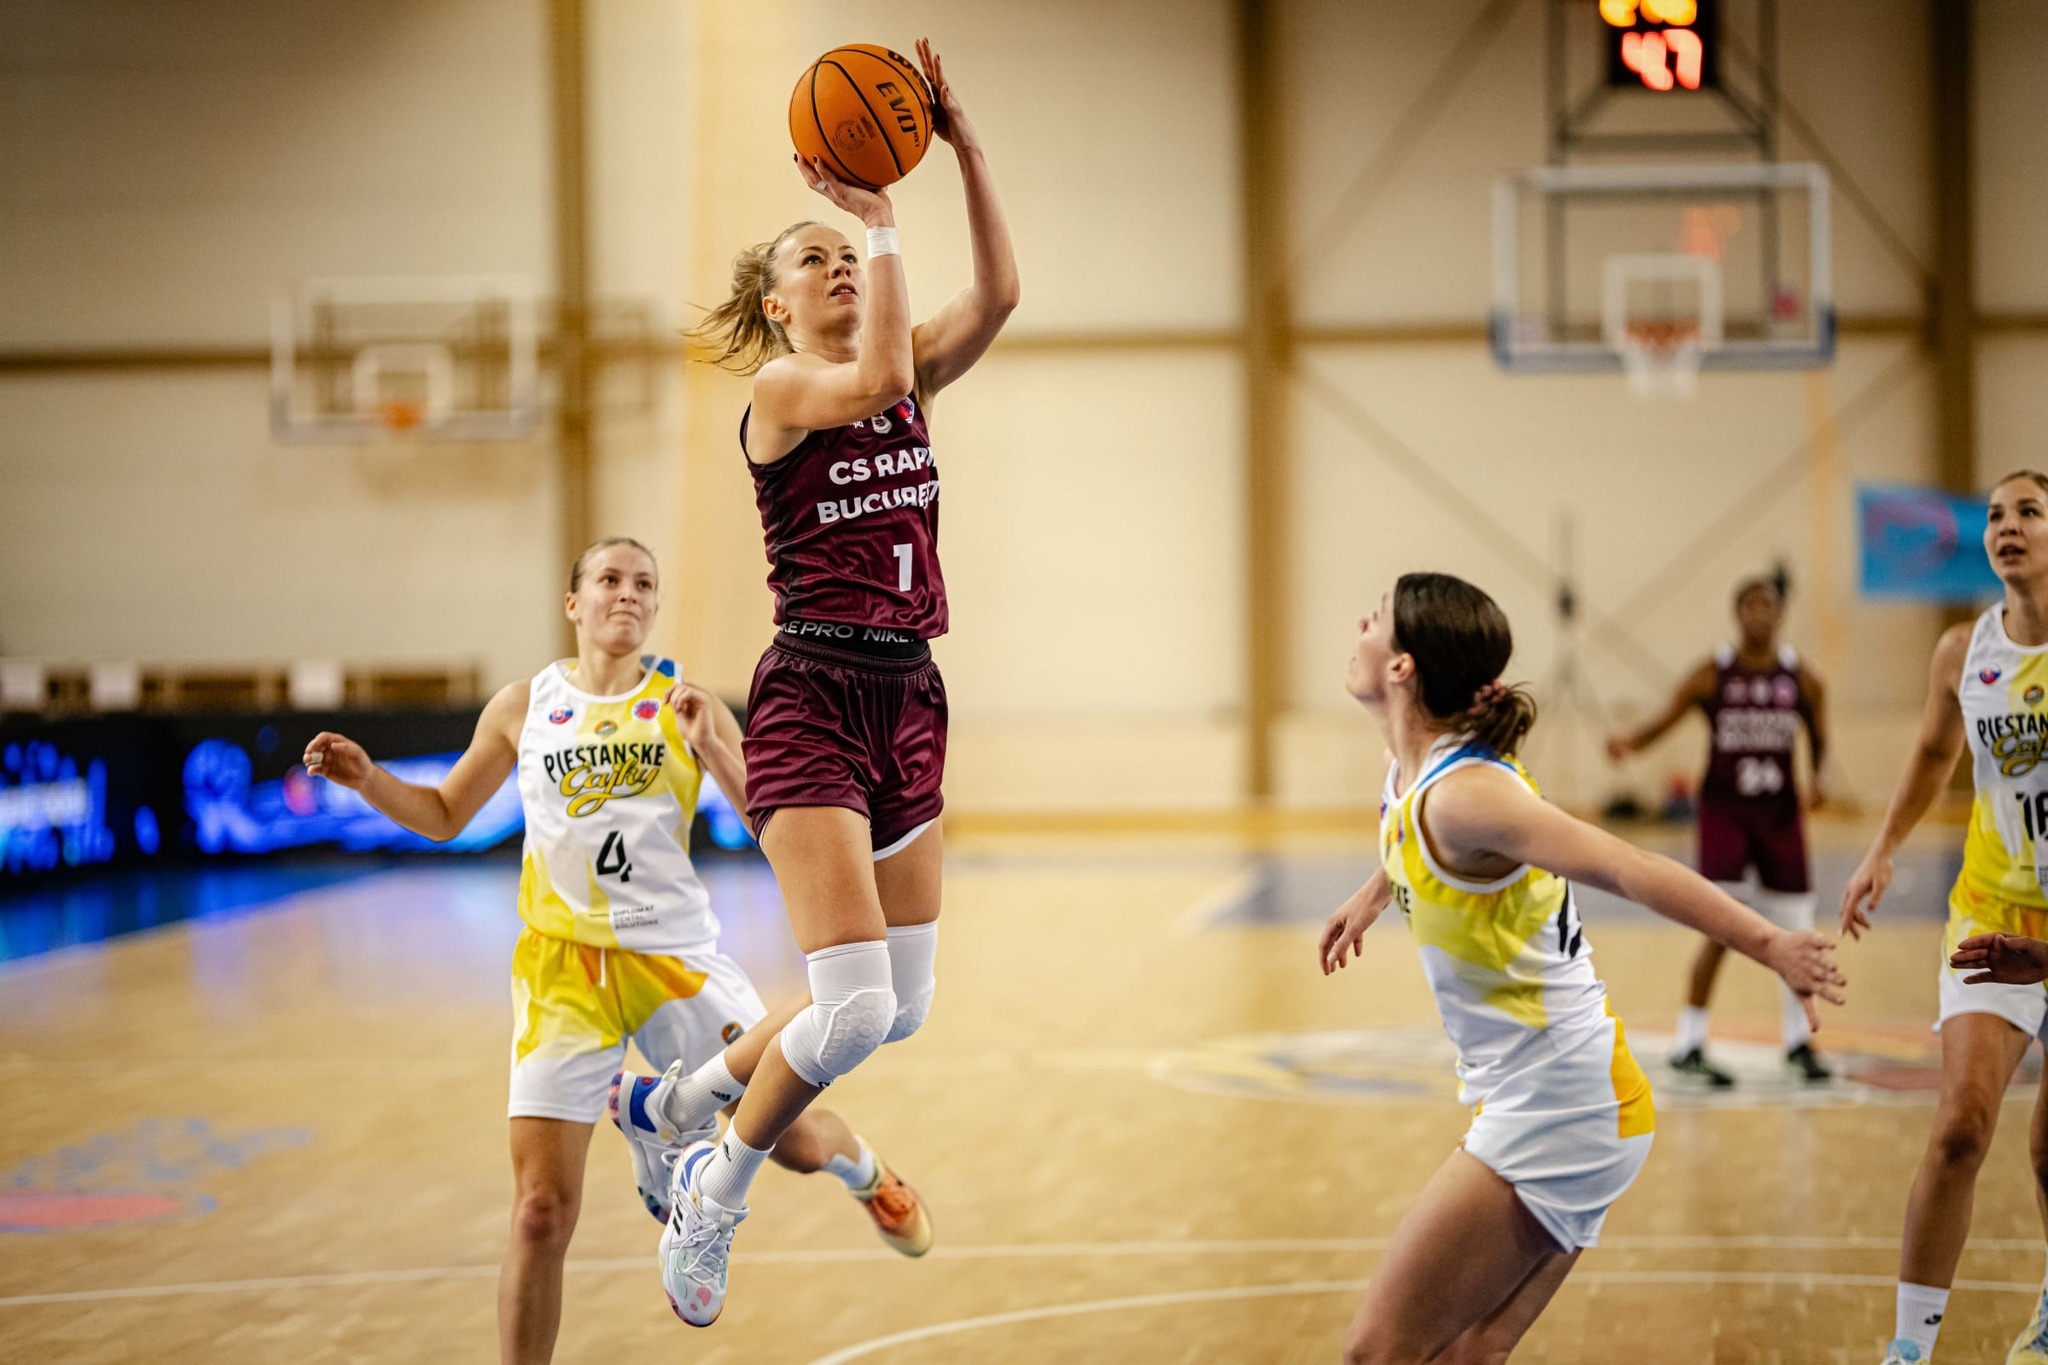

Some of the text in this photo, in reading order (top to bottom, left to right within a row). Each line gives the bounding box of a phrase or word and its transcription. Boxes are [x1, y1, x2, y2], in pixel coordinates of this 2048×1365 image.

[875, 81, 917, 133] EVO
[828, 446, 936, 485] CS RAPI
[893, 543, 913, 592] 1
[799, 621, 854, 639] PRO
[596, 830, 633, 883] 4
[613, 904, 654, 916] DIPLOMAT
